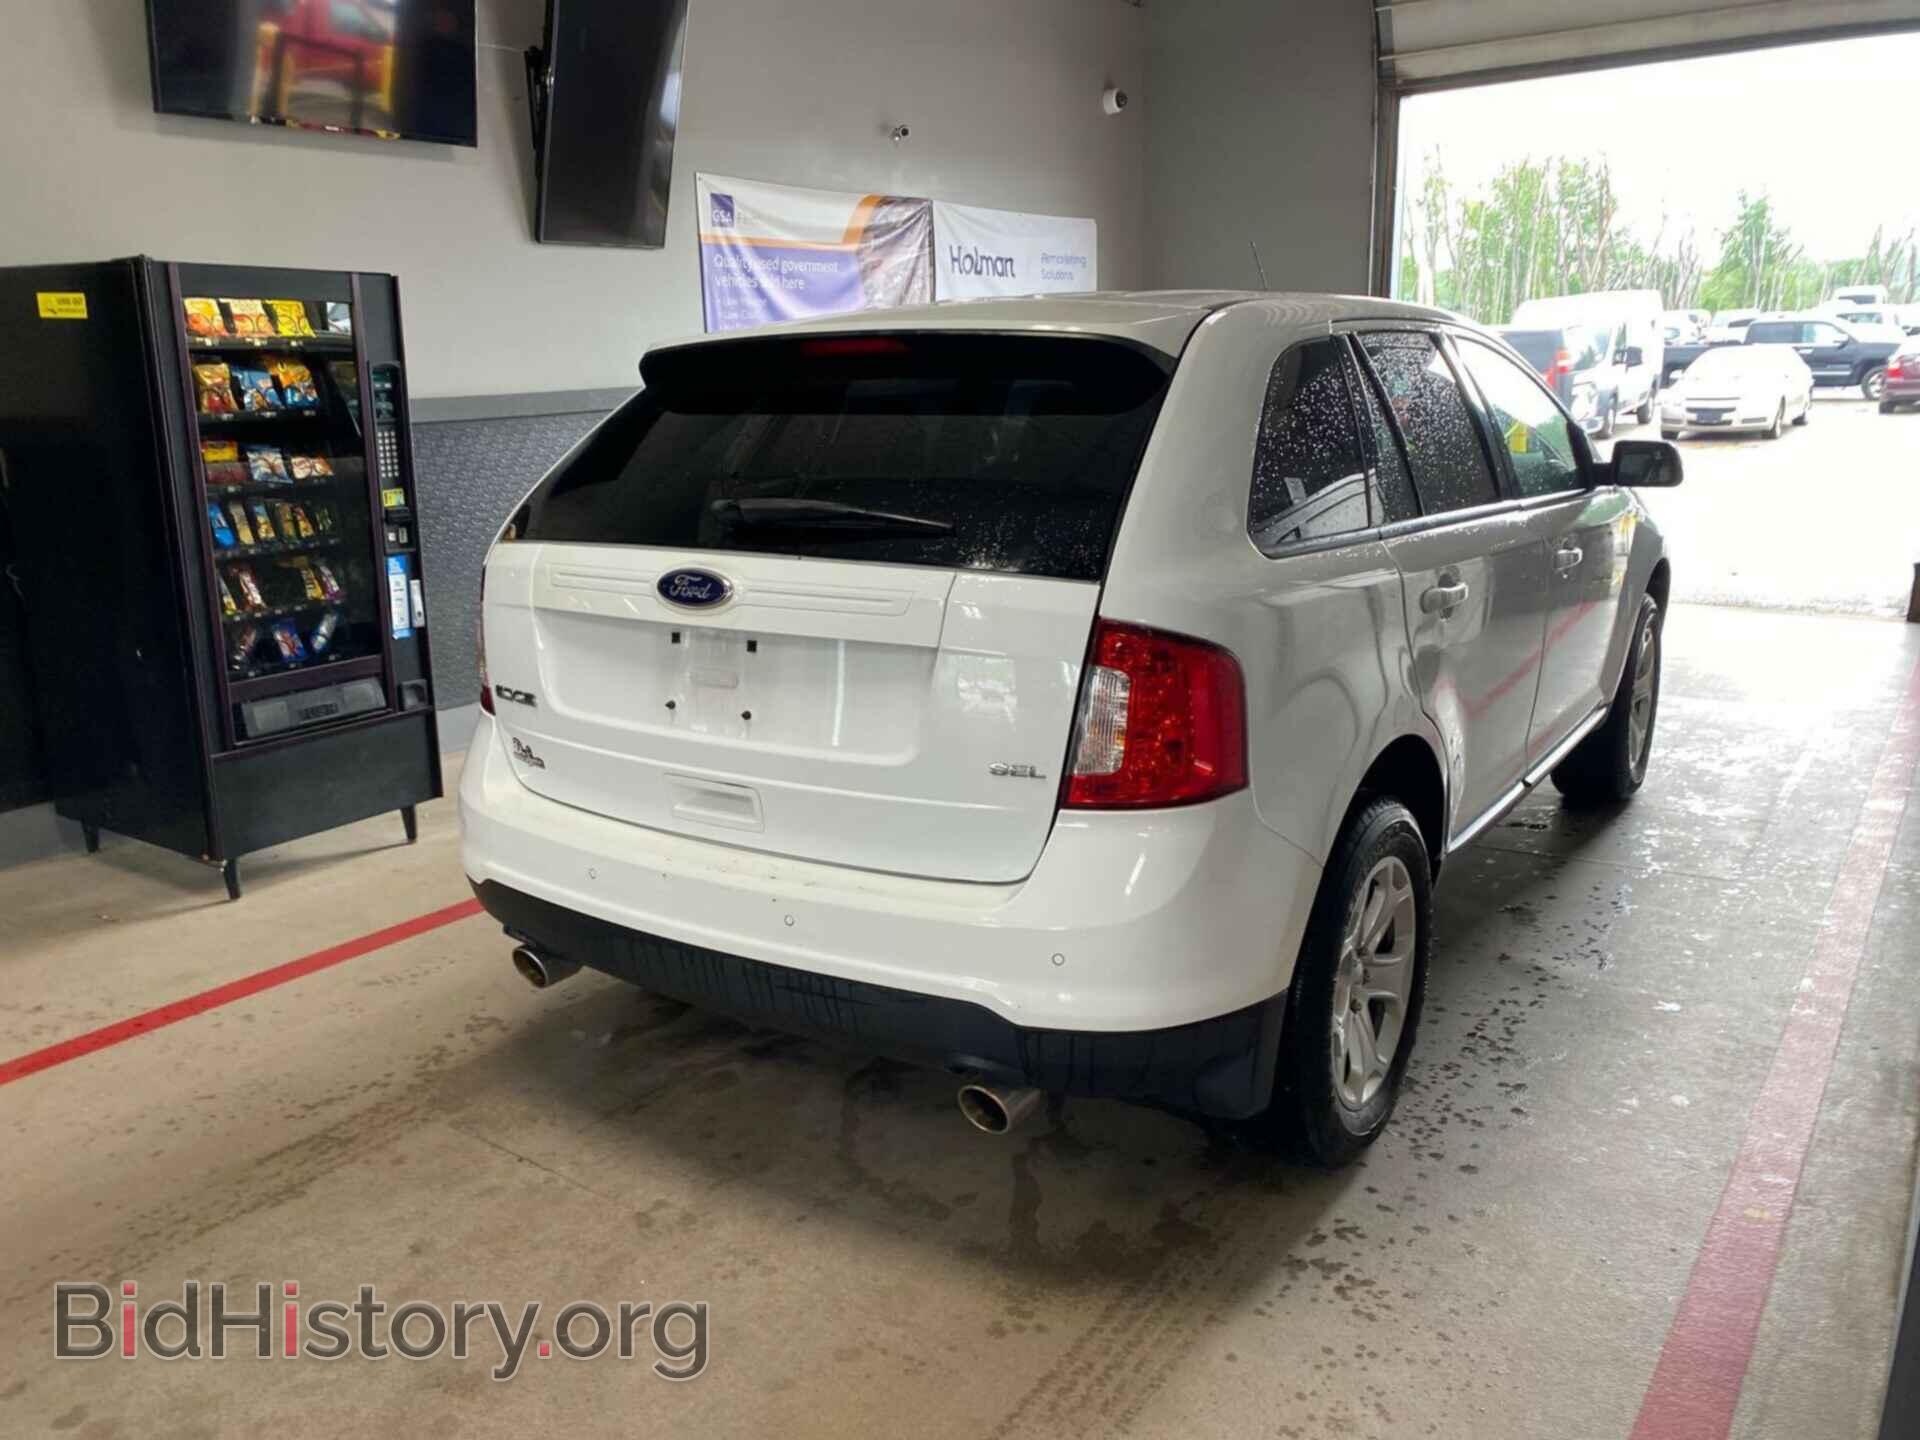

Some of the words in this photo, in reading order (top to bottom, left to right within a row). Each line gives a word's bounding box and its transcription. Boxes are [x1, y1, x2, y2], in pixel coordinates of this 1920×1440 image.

[712, 208, 732, 223] GSA
[782, 258, 838, 273] government
[949, 245, 1016, 278] Holman
[782, 277, 806, 290] here
[670, 574, 713, 599] Ford
[989, 763, 1047, 779] SEL
